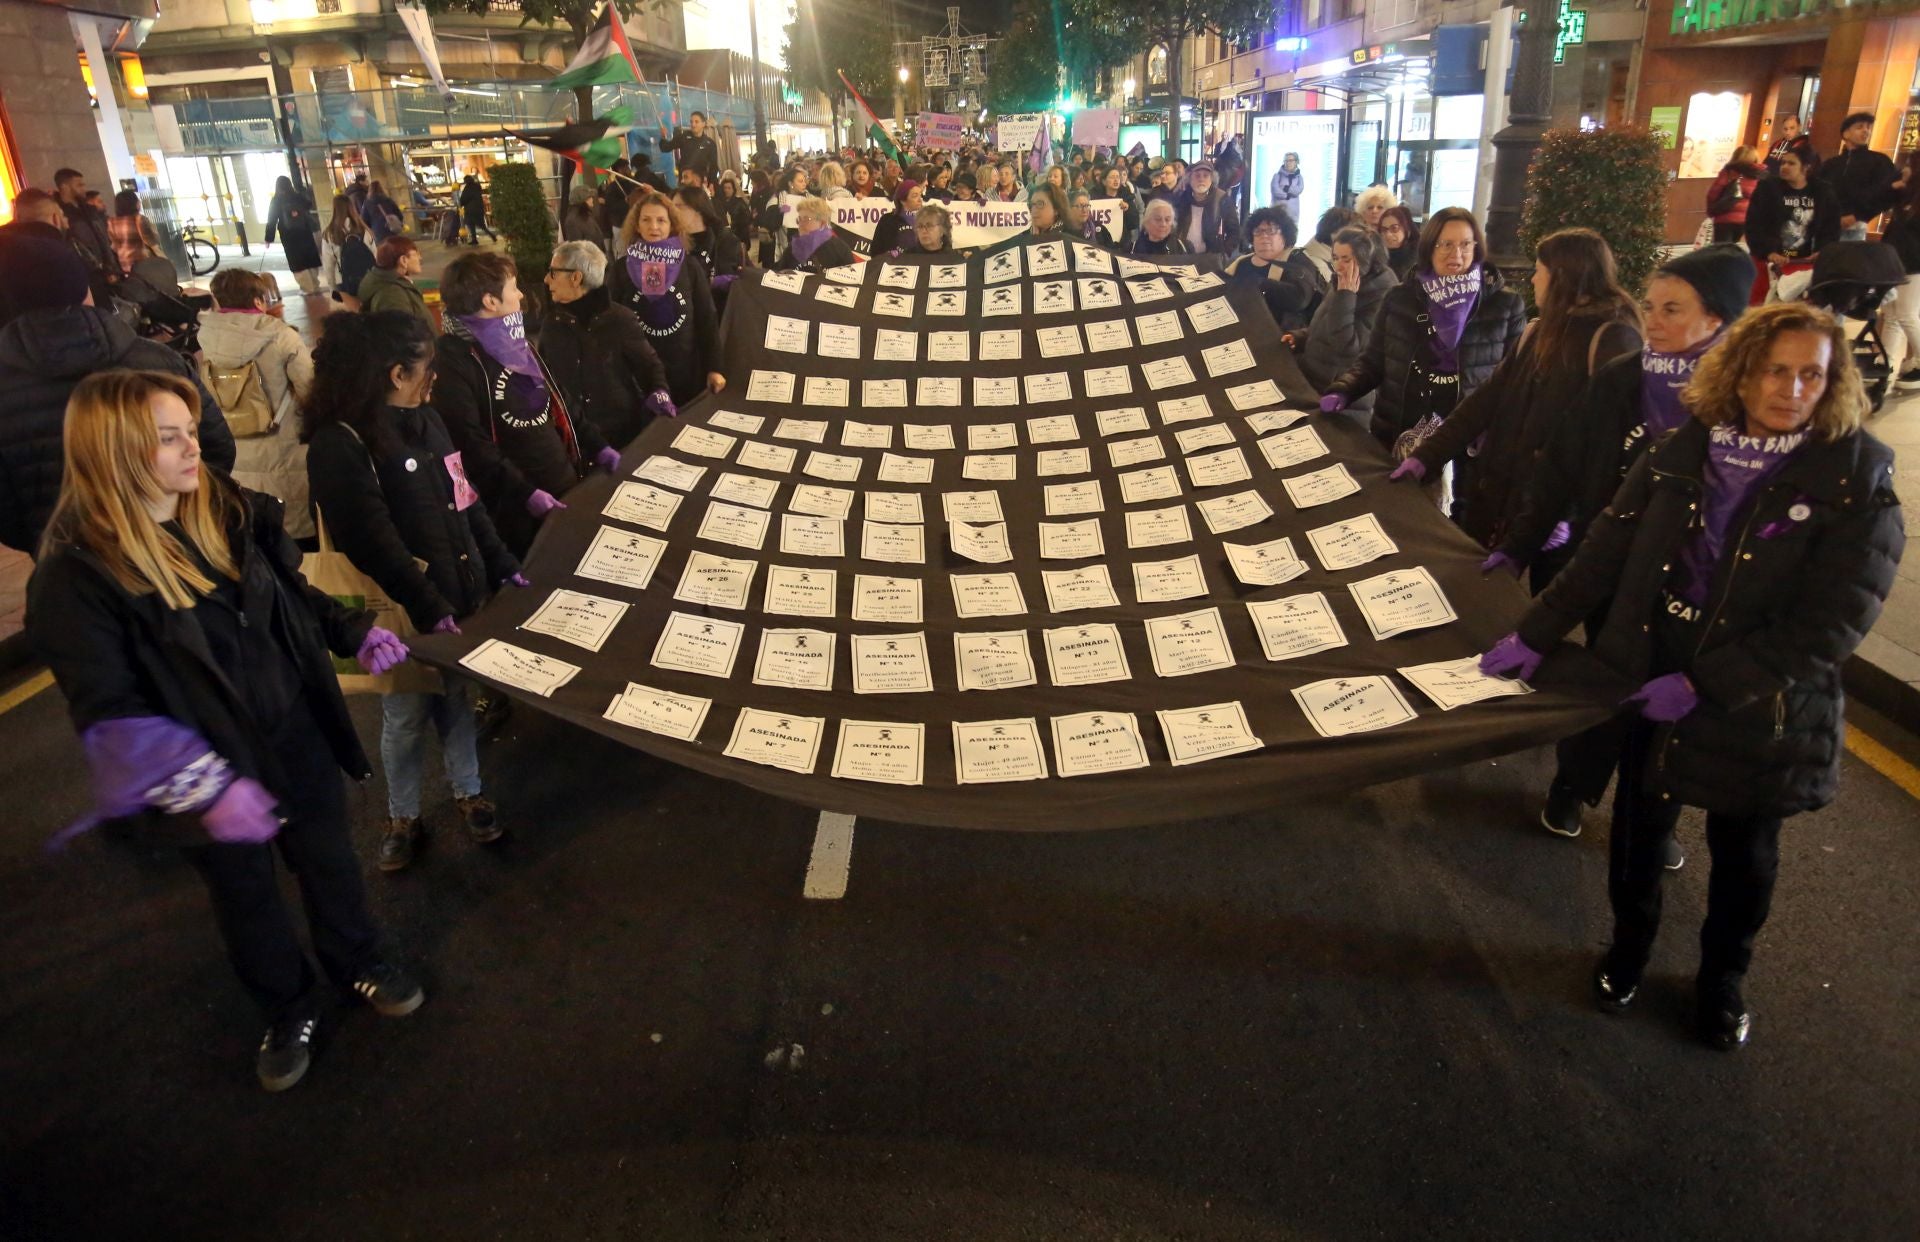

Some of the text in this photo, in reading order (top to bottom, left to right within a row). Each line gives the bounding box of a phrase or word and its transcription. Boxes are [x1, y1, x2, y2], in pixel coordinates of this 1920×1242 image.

[966, 211, 1028, 227] MUYERES
[603, 544, 650, 559] ASESINADA
[779, 583, 826, 591] ASESINADA
[1369, 580, 1423, 601] ASESINADA
[556, 605, 607, 619] ASESINADA
[1266, 609, 1319, 620] ASESINADA
[676, 632, 727, 646] ASESINADA
[1161, 630, 1213, 639] ASESINADA
[1059, 638, 1110, 652] ASESINADA
[772, 650, 823, 658] ASESINADA
[503, 646, 556, 677] ASESINADA
[1323, 683, 1375, 712] ASESINADA
[749, 727, 808, 744] ASESINADA
[1068, 726, 1127, 742] ASESINADA
